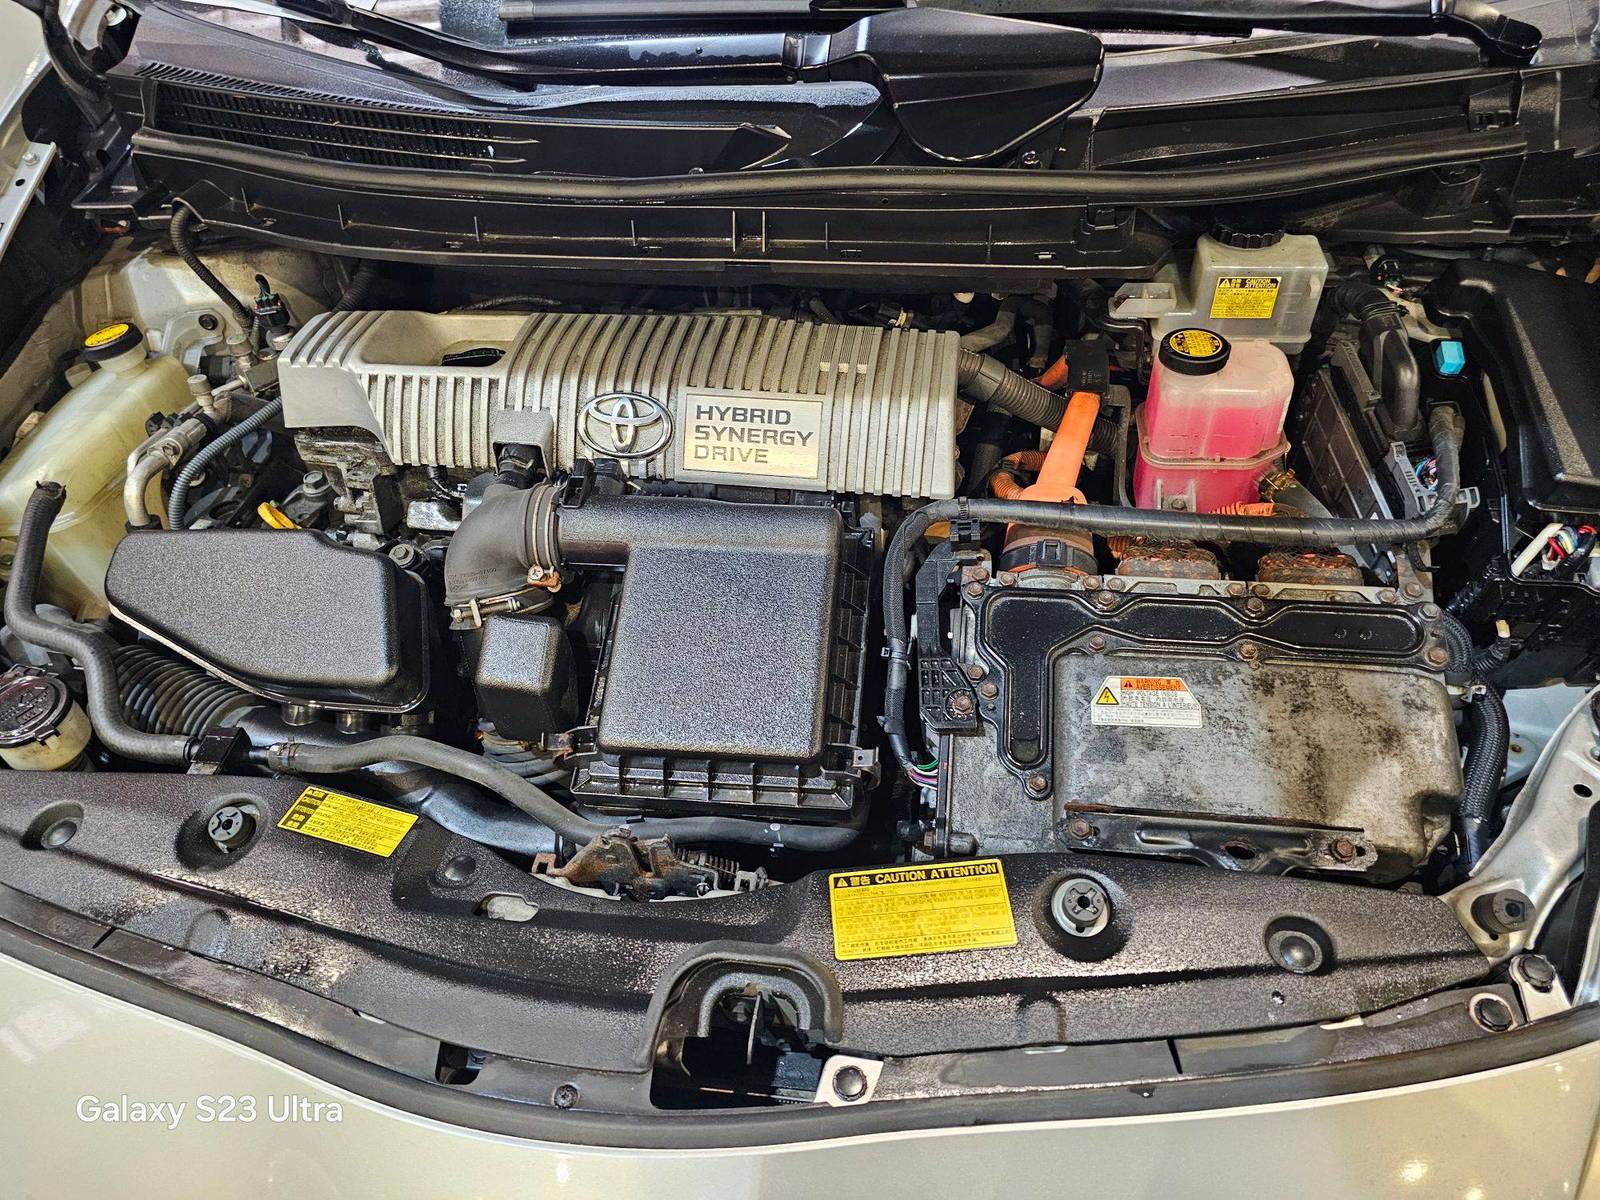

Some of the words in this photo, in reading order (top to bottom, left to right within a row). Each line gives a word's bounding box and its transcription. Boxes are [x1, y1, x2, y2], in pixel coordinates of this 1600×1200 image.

[696, 405, 792, 425] HYBRID
[694, 425, 814, 446] SYNERGY
[694, 445, 769, 464] DRIVE
[875, 870, 926, 884] CAUTION
[930, 863, 997, 880] ATTENTION
